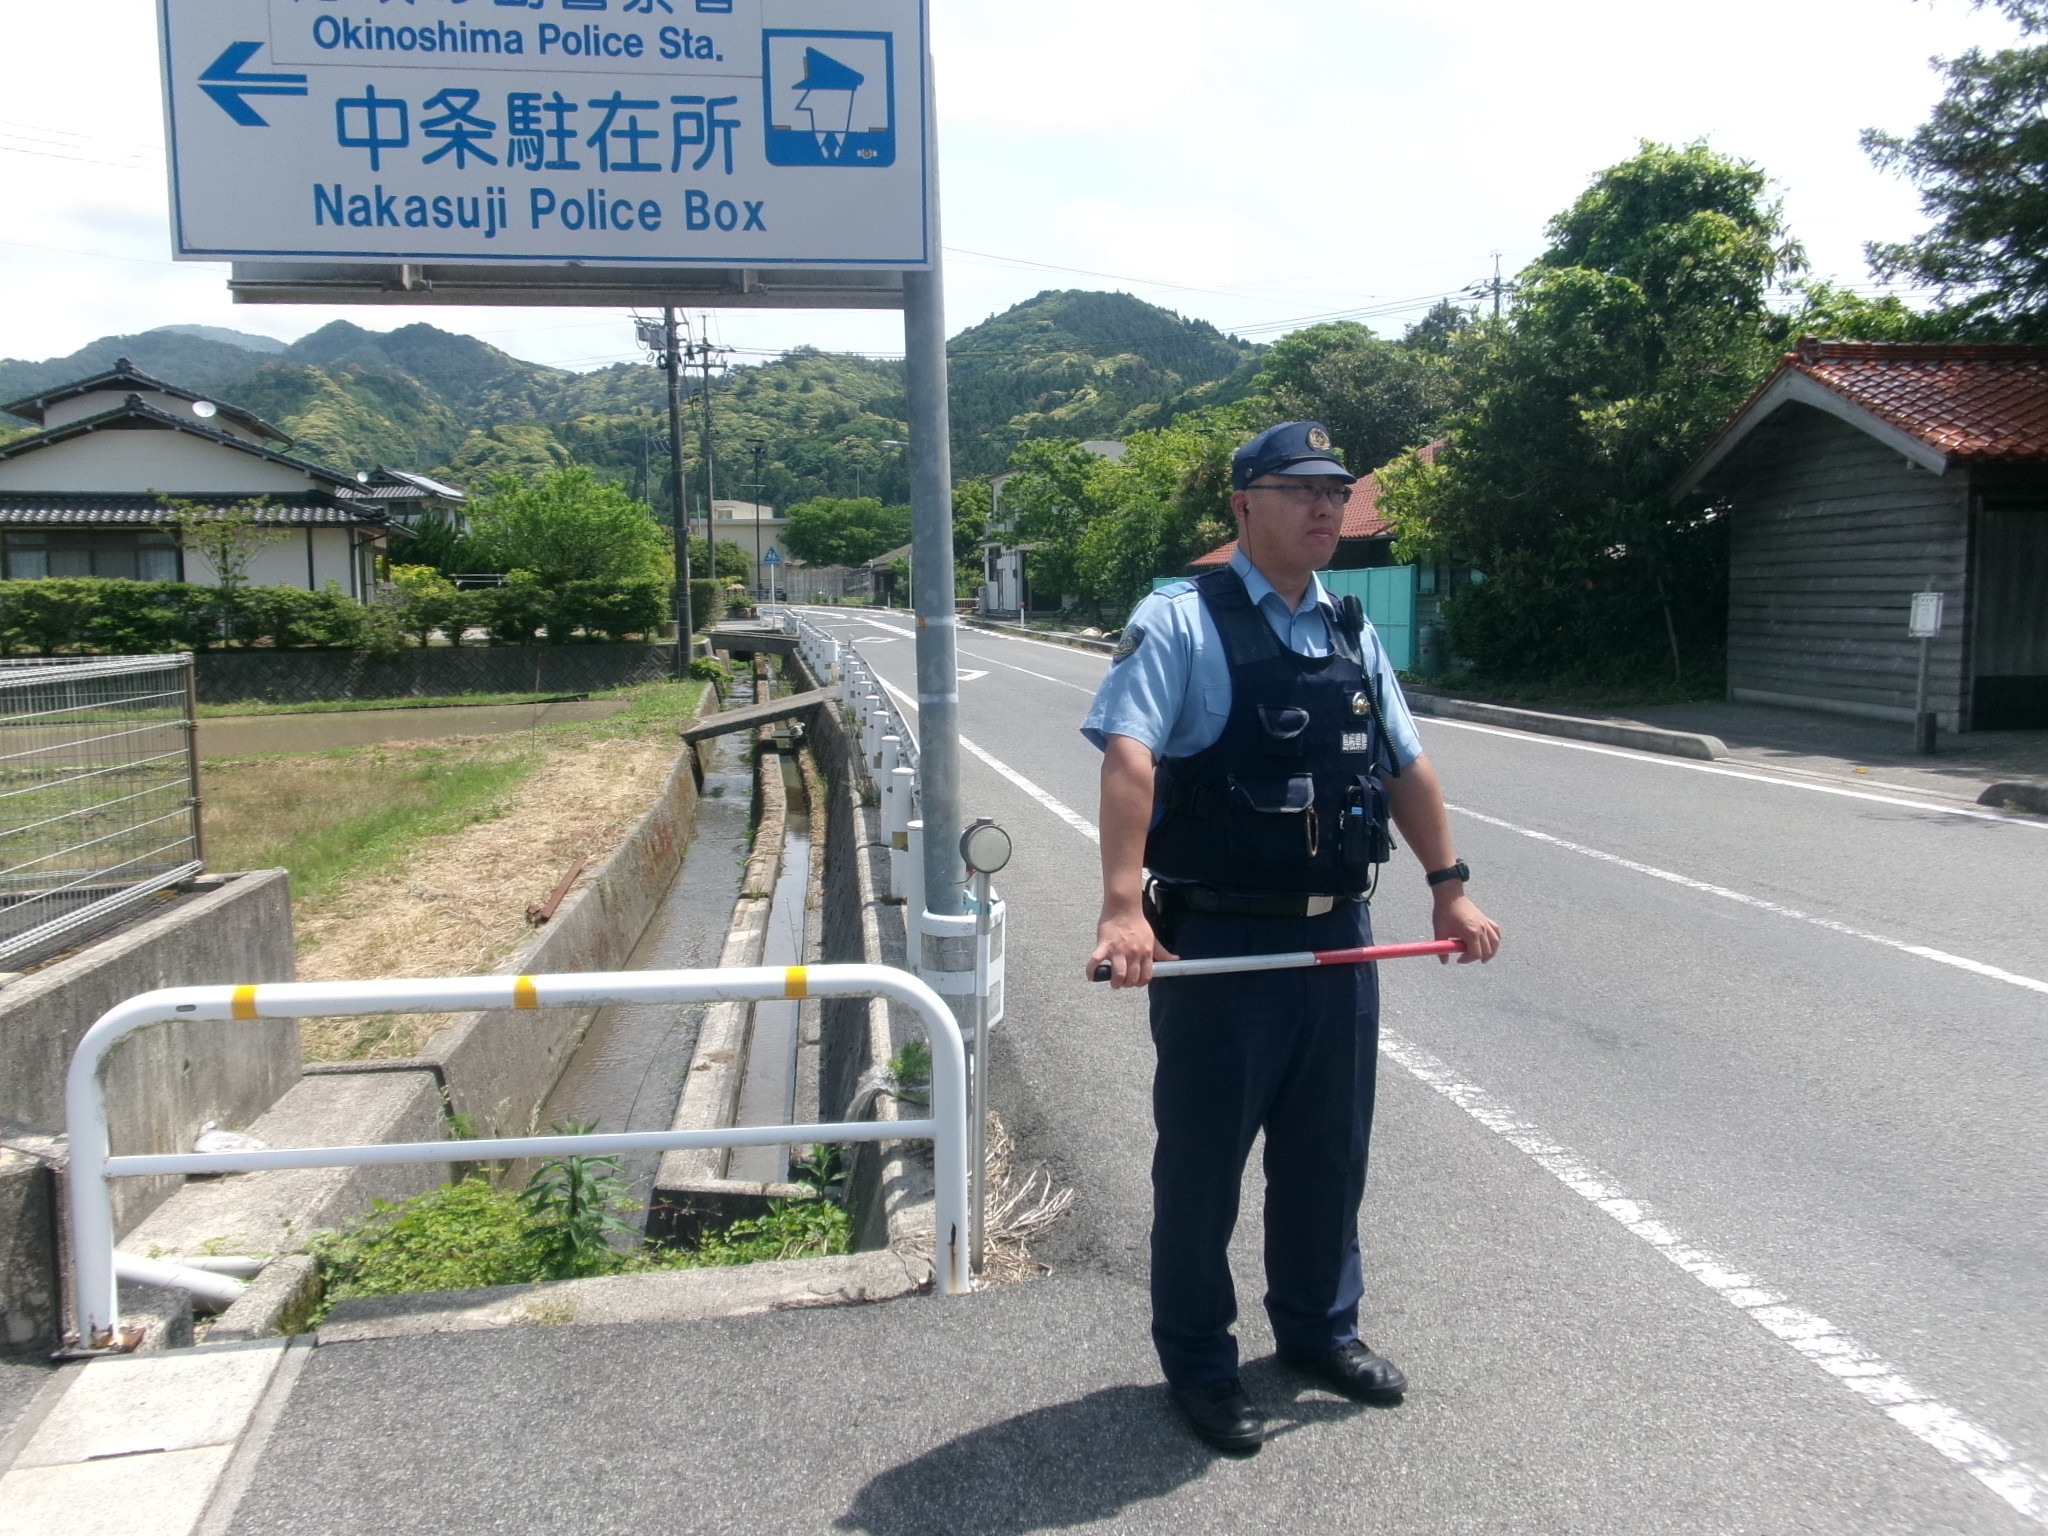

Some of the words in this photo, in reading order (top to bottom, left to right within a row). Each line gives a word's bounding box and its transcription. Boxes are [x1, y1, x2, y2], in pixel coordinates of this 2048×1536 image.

[312, 15, 524, 54] Okinoshima
[538, 22, 643, 57] Police
[659, 26, 724, 62] Sta.
[335, 84, 742, 175] 中条駐在所
[313, 183, 508, 239] Nakasuji
[530, 187, 661, 232] Police
[684, 189, 767, 232] Box
